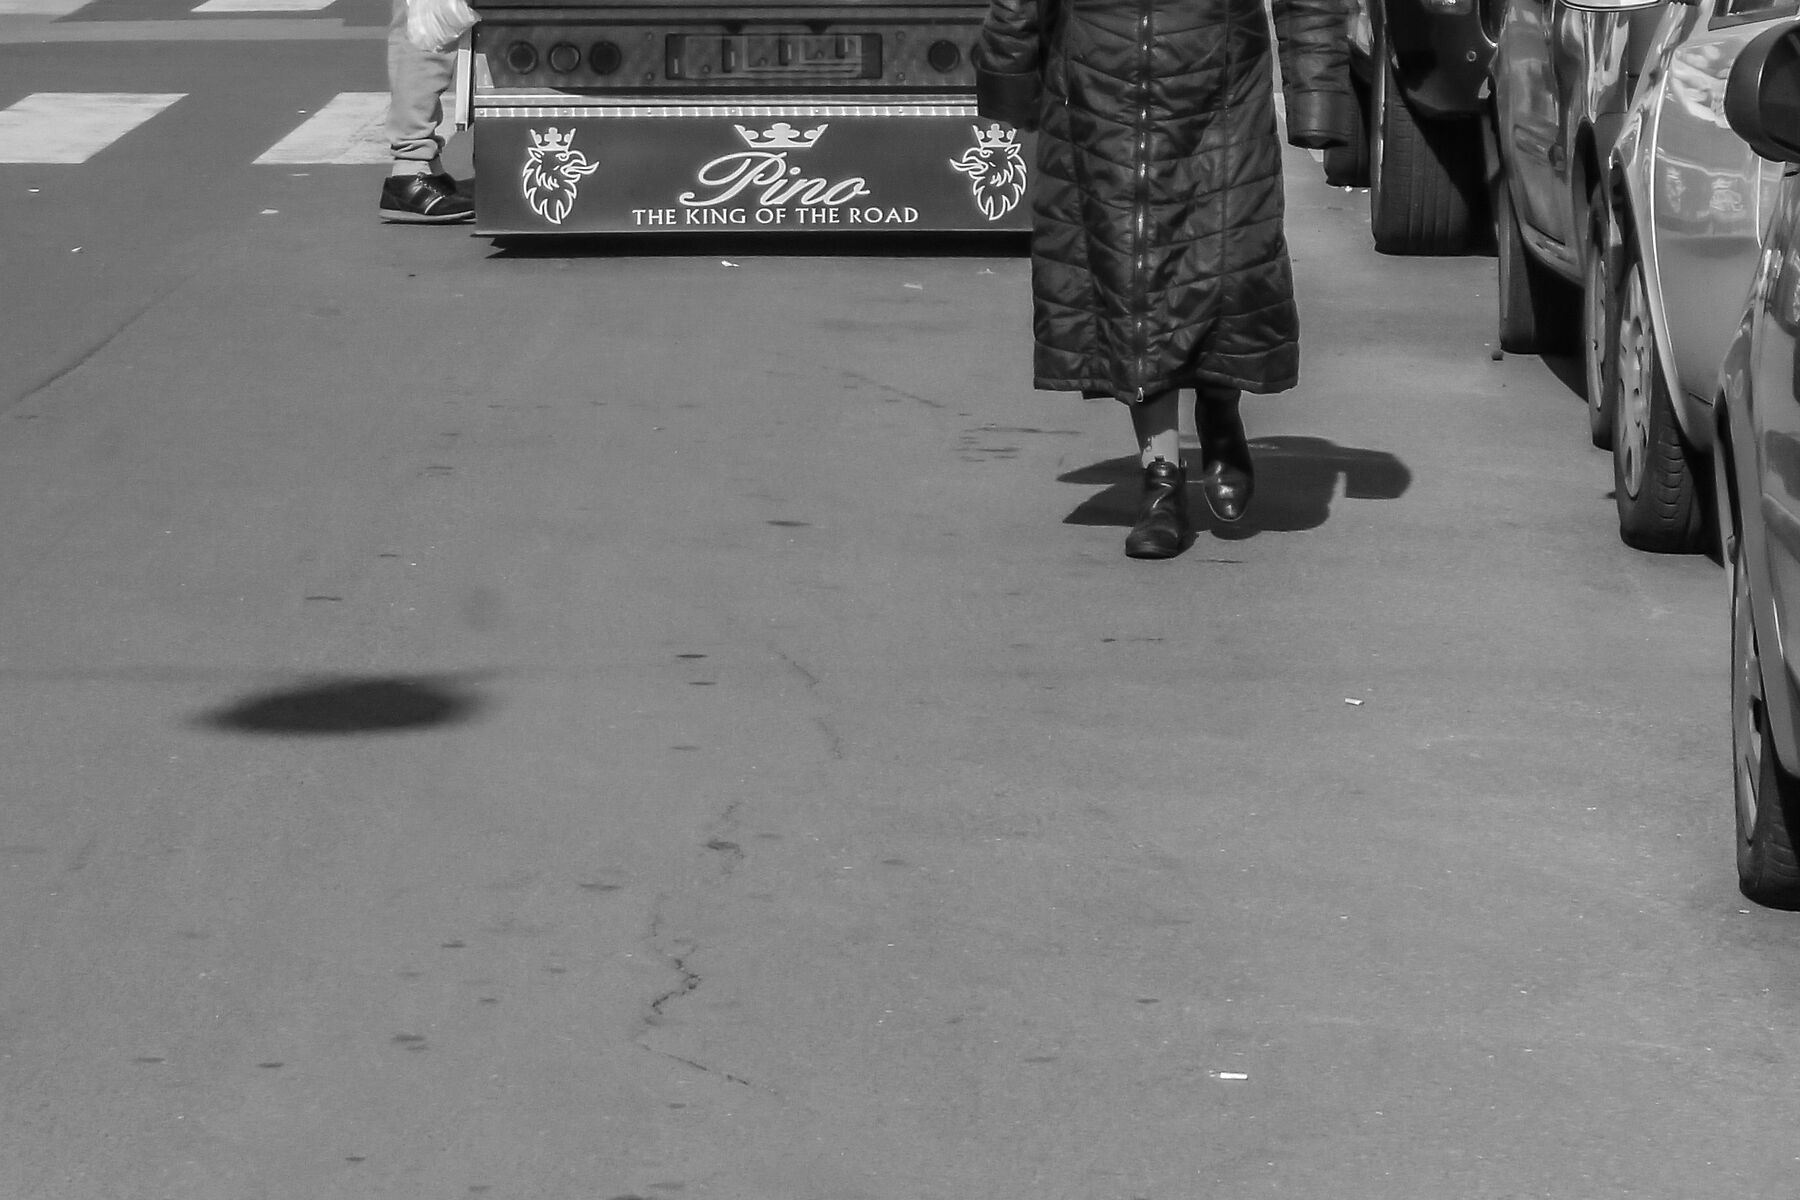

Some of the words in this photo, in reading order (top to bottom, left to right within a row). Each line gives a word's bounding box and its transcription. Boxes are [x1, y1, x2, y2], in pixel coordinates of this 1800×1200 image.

[679, 151, 870, 206] Pino
[632, 208, 677, 225] THE
[686, 207, 747, 225] KING
[755, 207, 788, 224] OF
[795, 207, 840, 224] THE
[849, 206, 919, 224] ROAD
